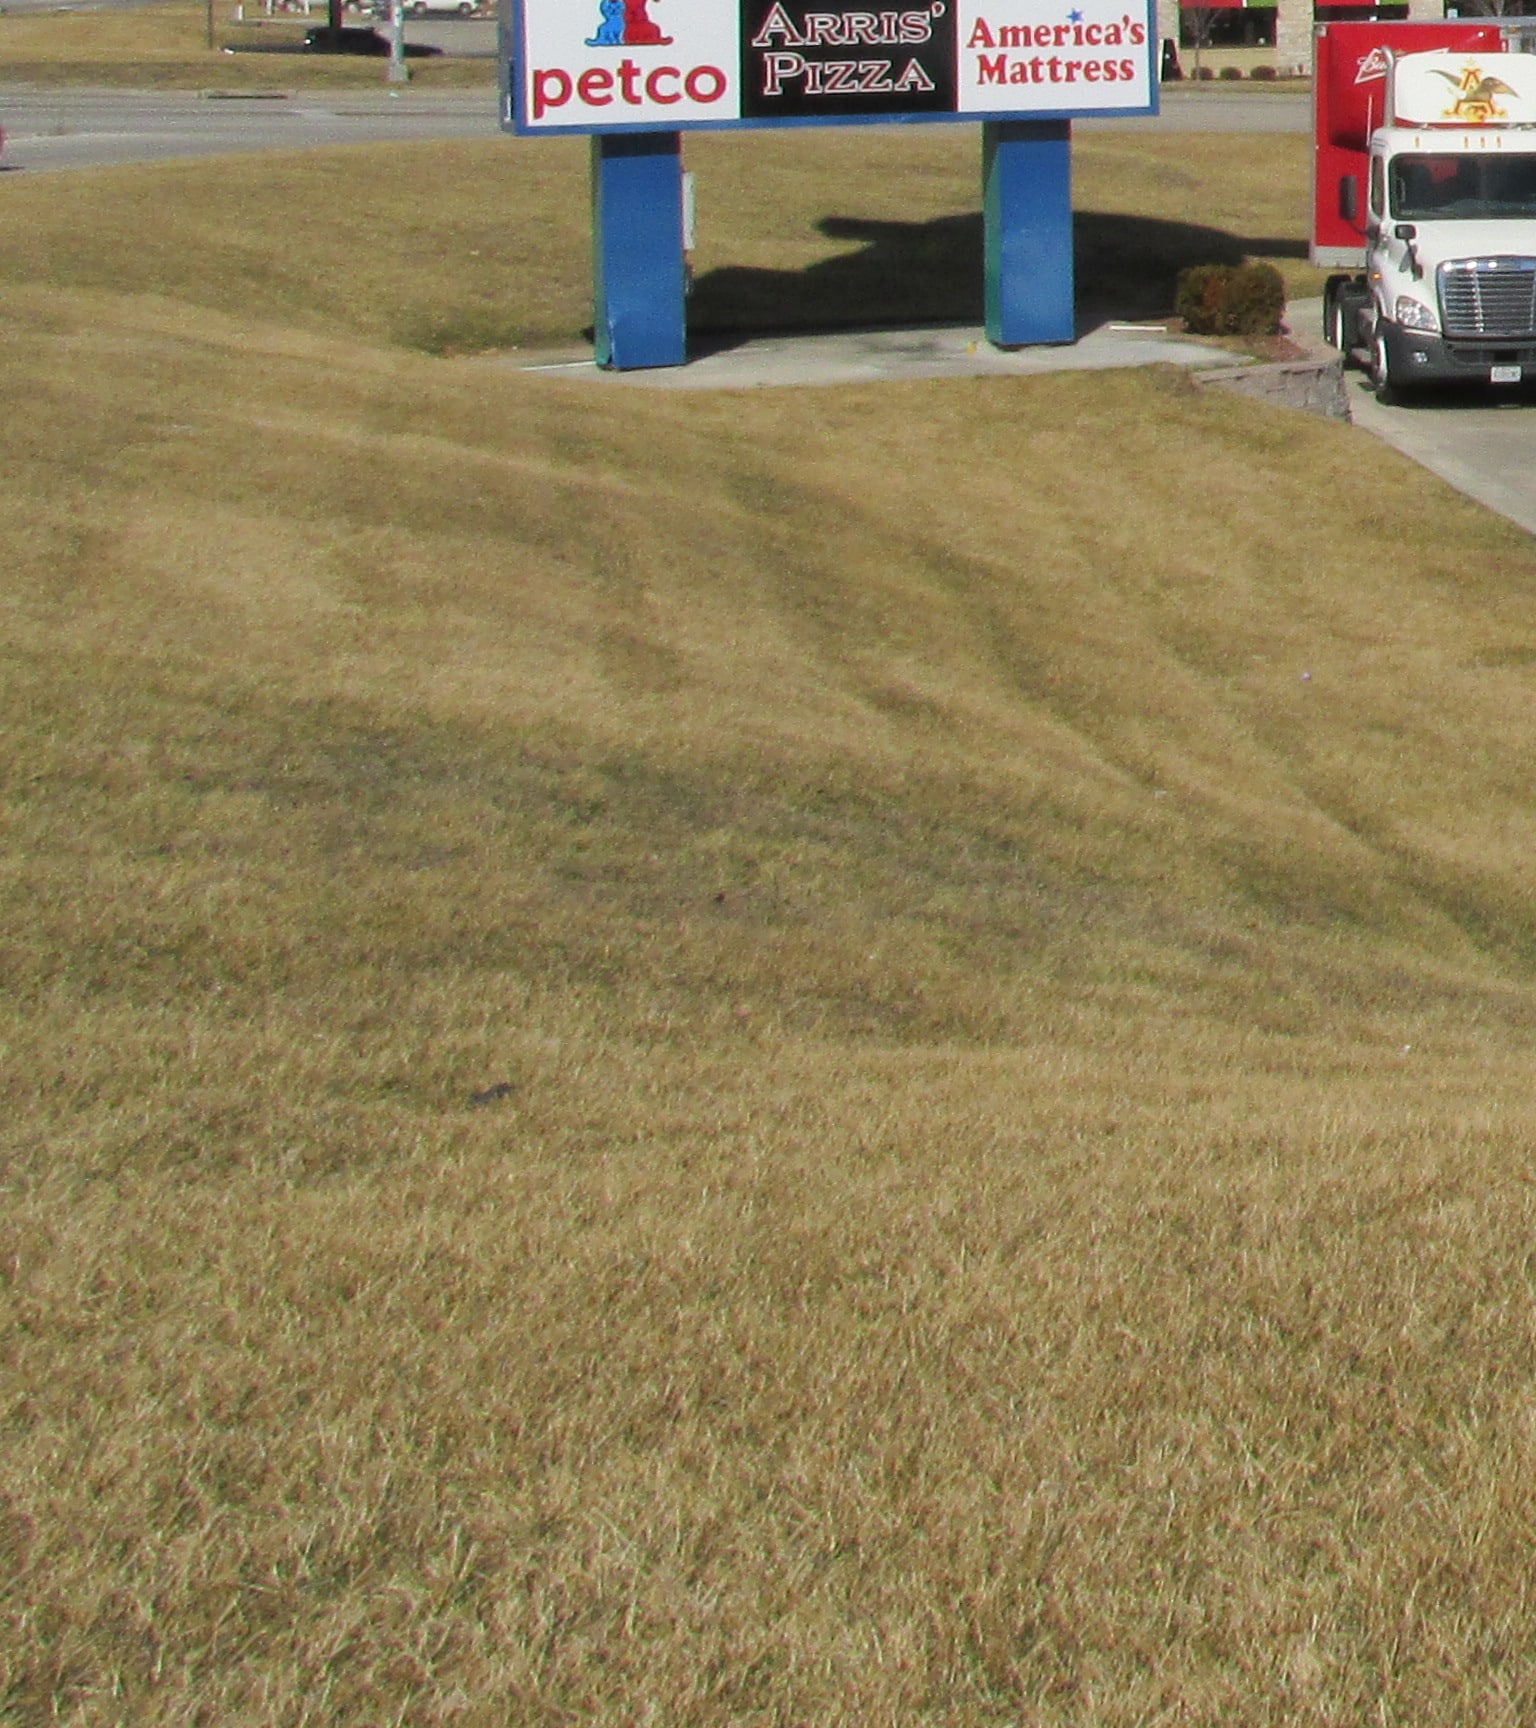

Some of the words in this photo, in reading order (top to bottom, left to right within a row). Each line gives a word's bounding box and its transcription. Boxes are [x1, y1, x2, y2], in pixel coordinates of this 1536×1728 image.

[752, 1, 946, 47] ARRIS'
[966, 13, 1146, 49] America's
[534, 59, 727, 120] petco
[763, 51, 936, 96] PIZZA
[976, 53, 1135, 86] Mattress
